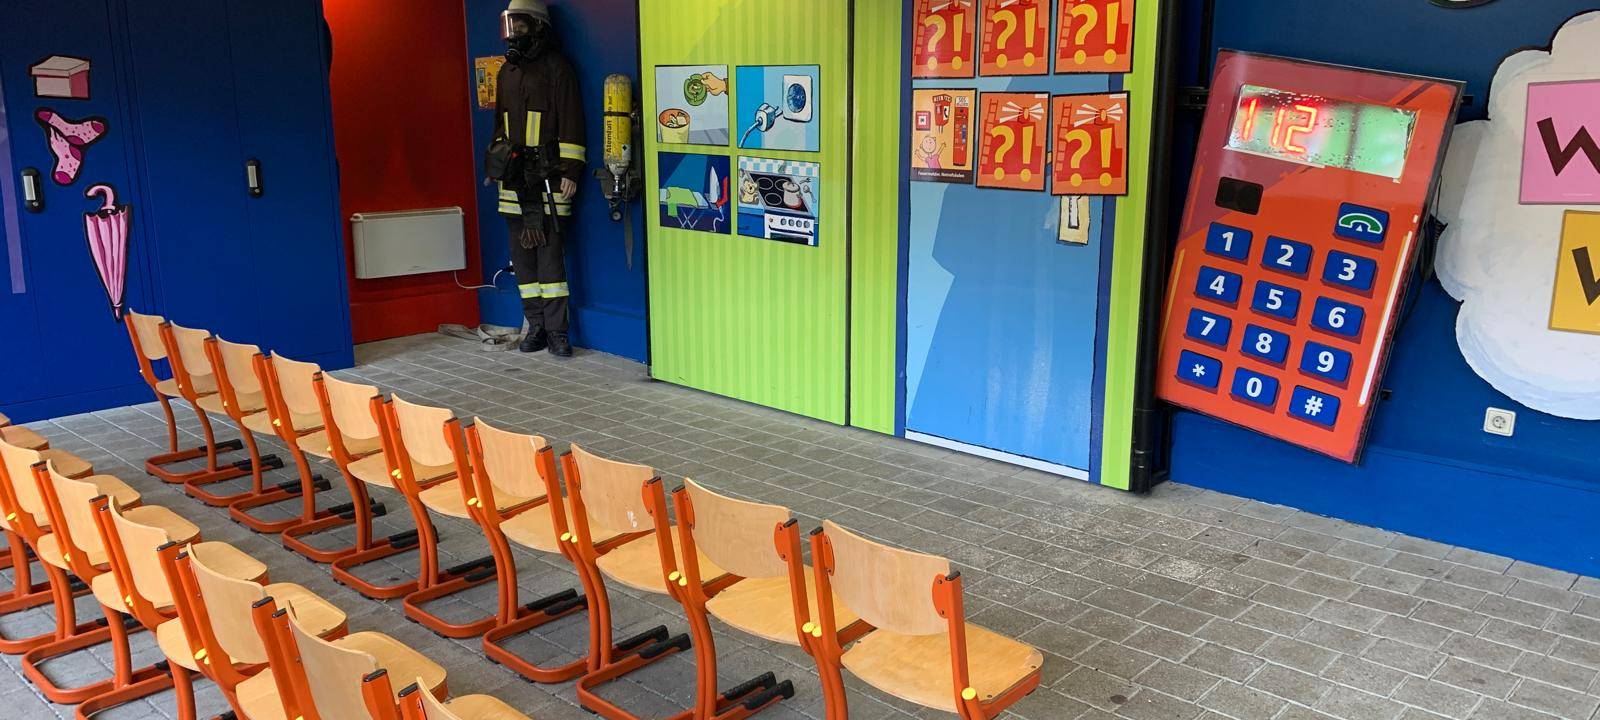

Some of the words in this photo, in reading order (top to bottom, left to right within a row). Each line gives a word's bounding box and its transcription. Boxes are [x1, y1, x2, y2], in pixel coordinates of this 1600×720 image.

[1241, 98, 1318, 154] 112
[1222, 231, 1235, 252] 1
[1276, 244, 1295, 267] 2
[1338, 258, 1358, 281] 3
[1209, 275, 1225, 295] 4
[1266, 288, 1284, 310] 5
[1328, 306, 1346, 328] 6
[1200, 316, 1216, 336] 7
[1255, 332, 1273, 354] 8
[1316, 351, 1335, 373] 9
[1246, 377, 1263, 398] 0
[1304, 395, 1323, 416] #
